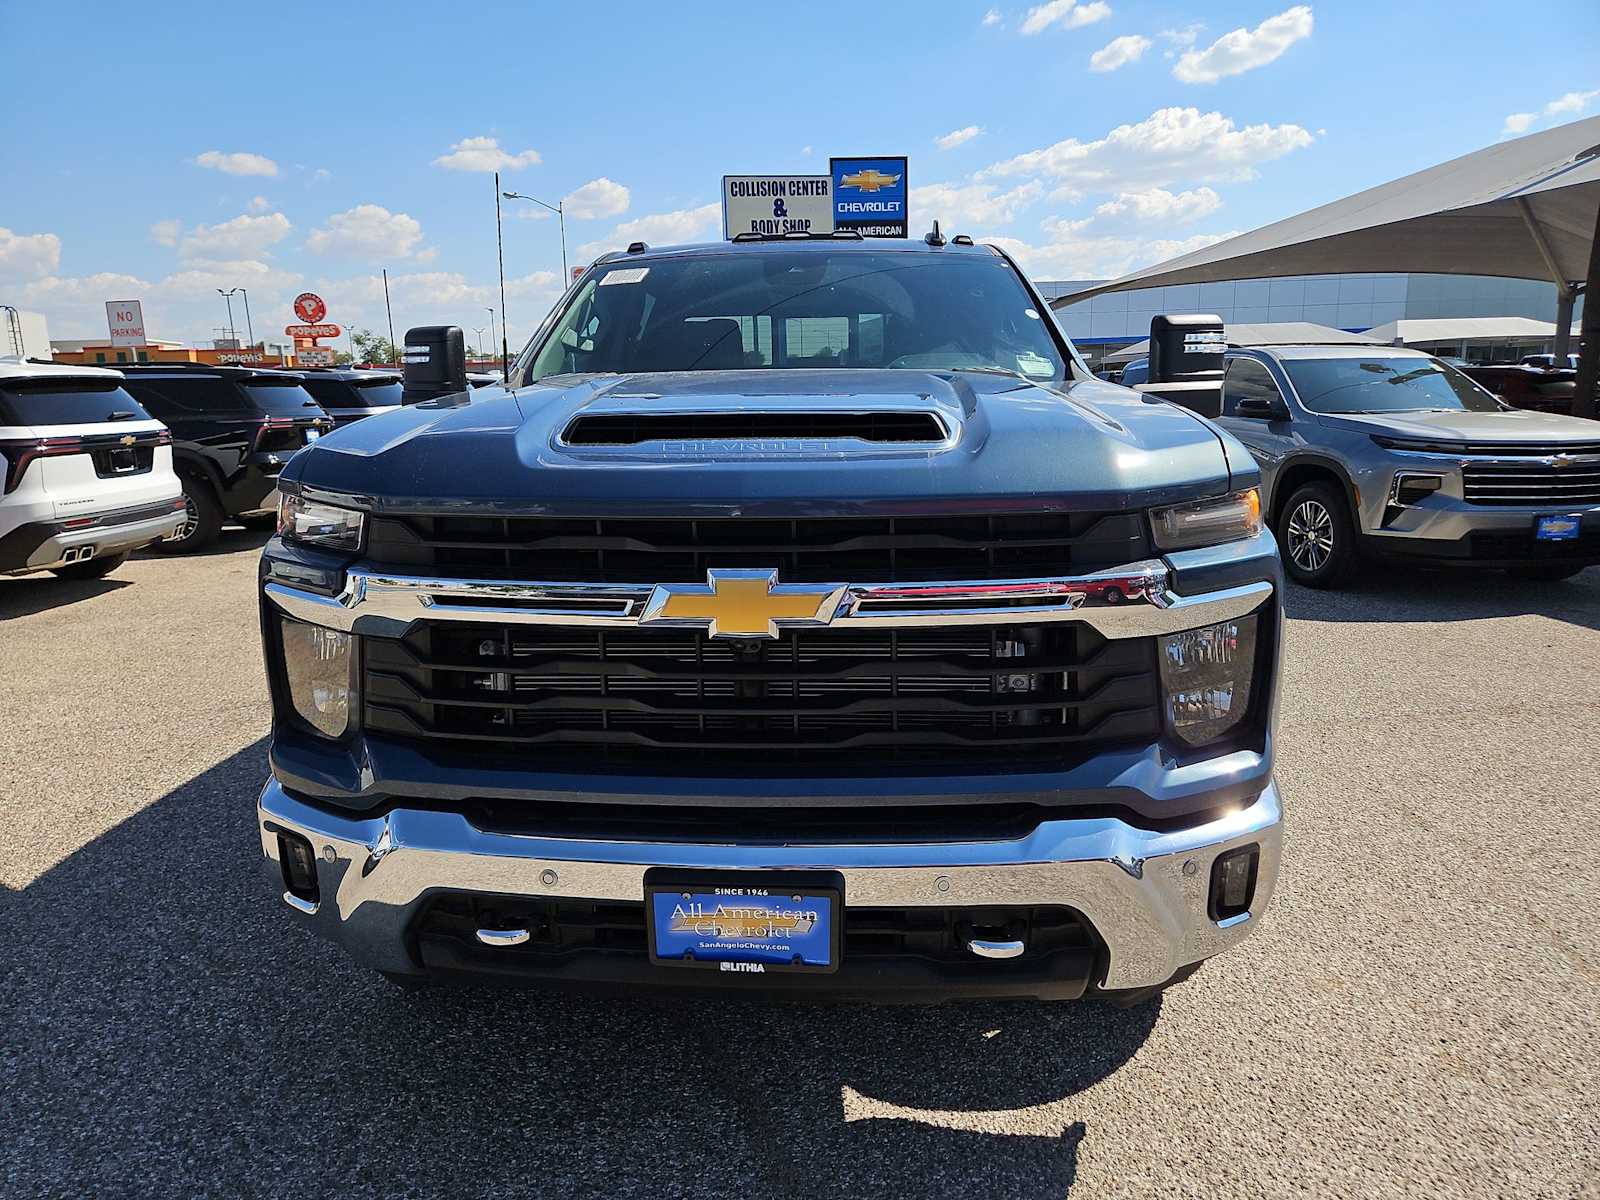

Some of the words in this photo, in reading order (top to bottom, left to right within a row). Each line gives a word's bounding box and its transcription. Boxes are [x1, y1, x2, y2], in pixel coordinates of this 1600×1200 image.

[730, 181, 786, 197] COLLISION
[788, 180, 828, 196] CENTER
[773, 198, 788, 218] &
[837, 202, 901, 213] CHEVROLET
[751, 219, 780, 233] BODY
[782, 219, 811, 233] SHOP
[857, 226, 902, 236] AMERICAN
[116, 311, 134, 322] NO
[111, 328, 144, 337] PARKING
[661, 441, 833, 458] CHEVROLET
[714, 888, 744, 896] SINCE
[746, 888, 769, 897] 1946
[671, 903, 703, 920] All
[711, 903, 818, 922] American
[693, 920, 793, 939] Chevrolet
[698, 941, 791, 951] SanAngeloChevy.com
[730, 962, 766, 973] LITHIA
